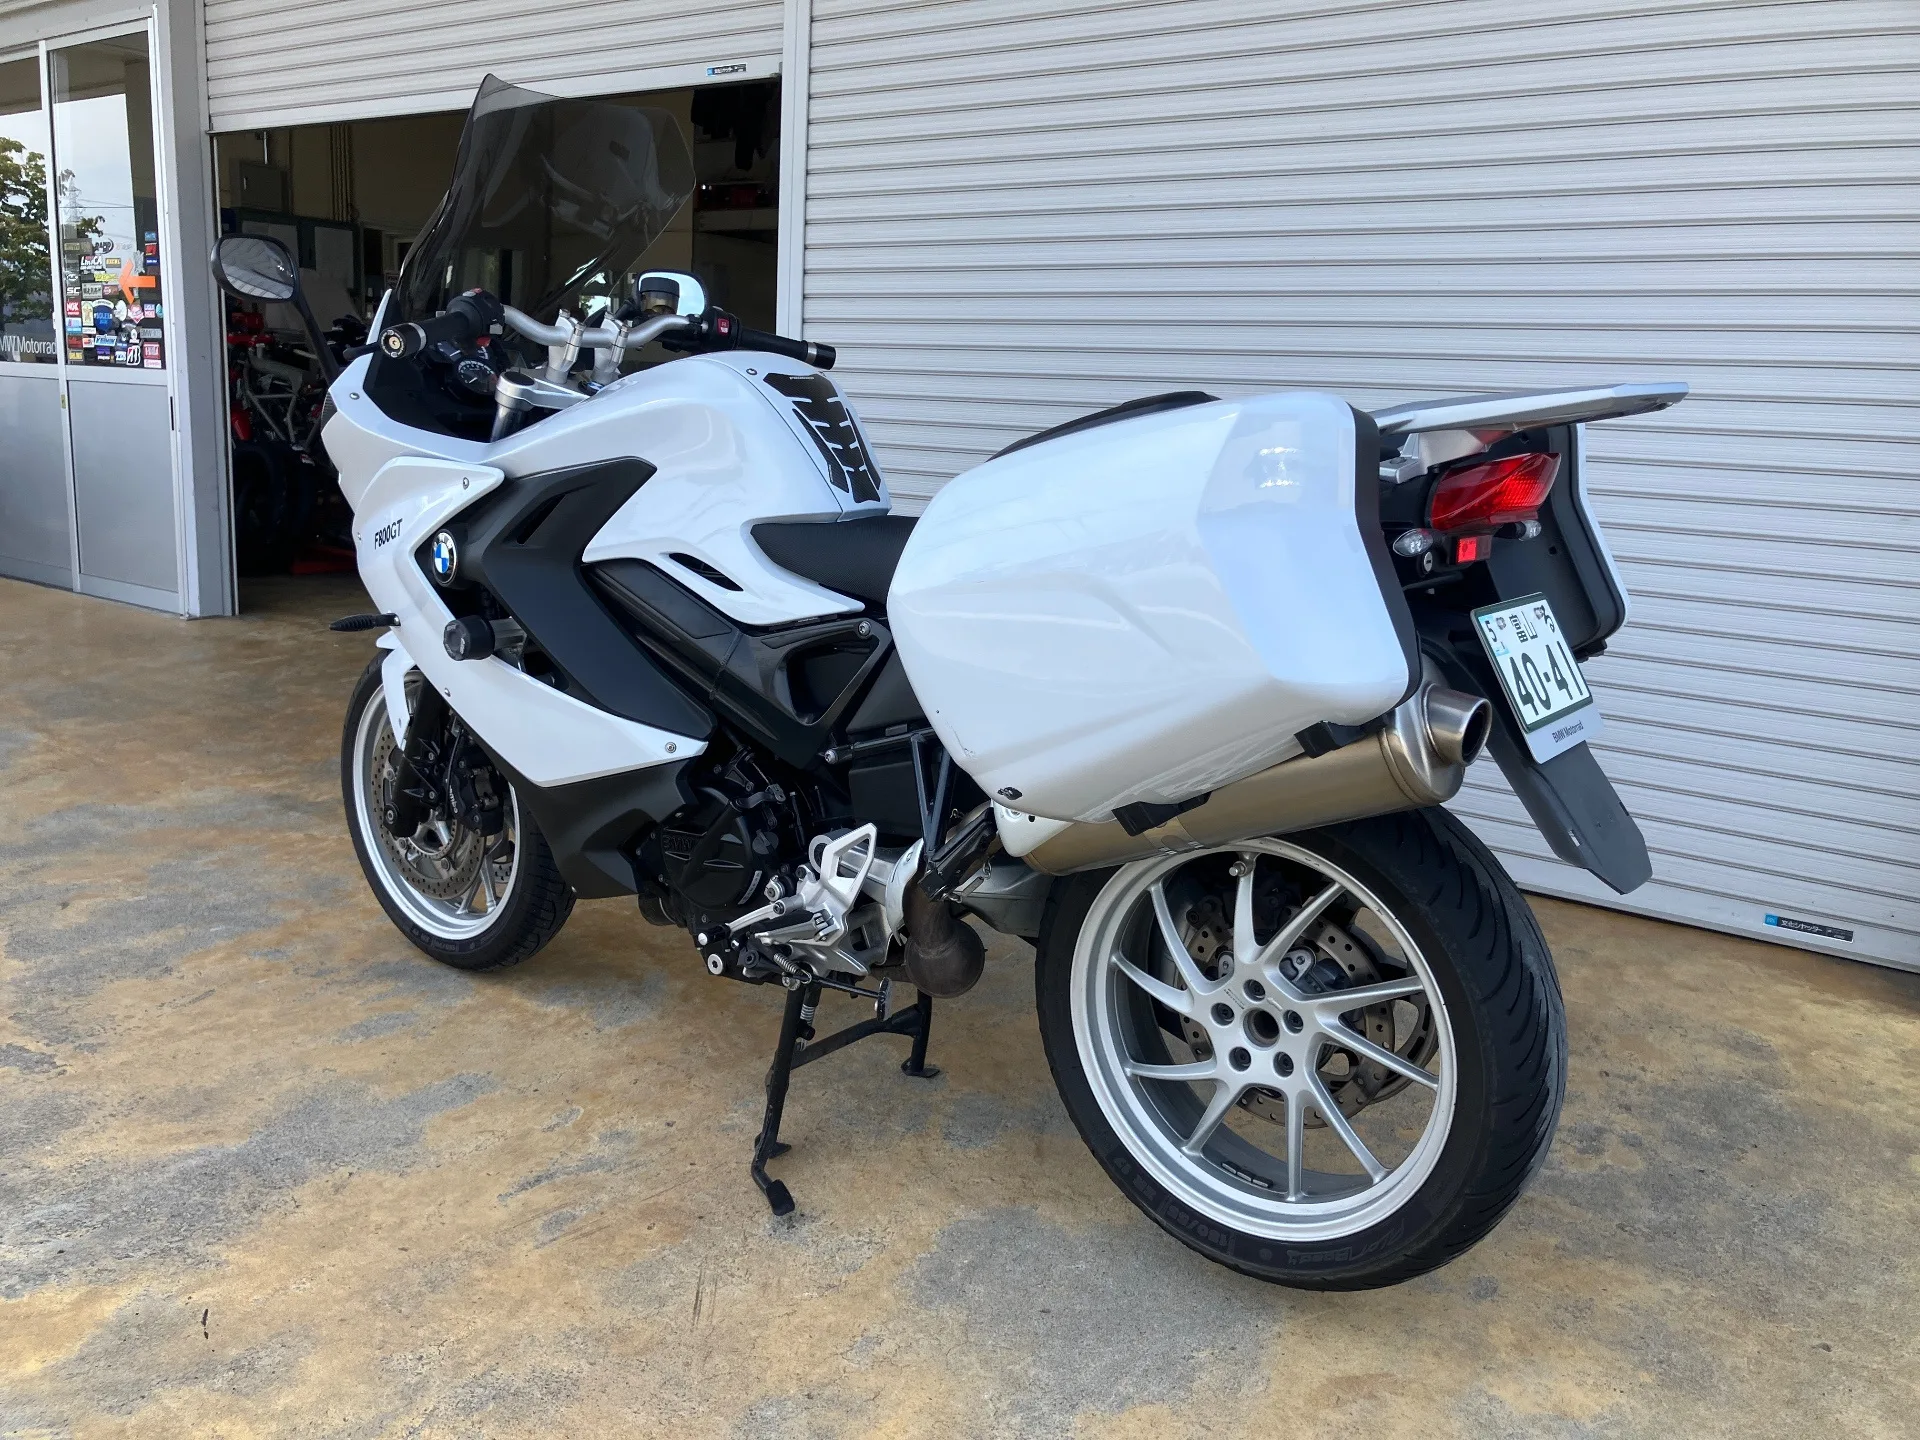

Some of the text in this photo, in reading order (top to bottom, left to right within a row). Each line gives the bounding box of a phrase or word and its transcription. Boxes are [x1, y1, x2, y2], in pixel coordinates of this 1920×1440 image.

[17, 335, 57, 355] Motorrad
[374, 518, 403, 550] F800GT
[1508, 610, 1539, 643] 富山
